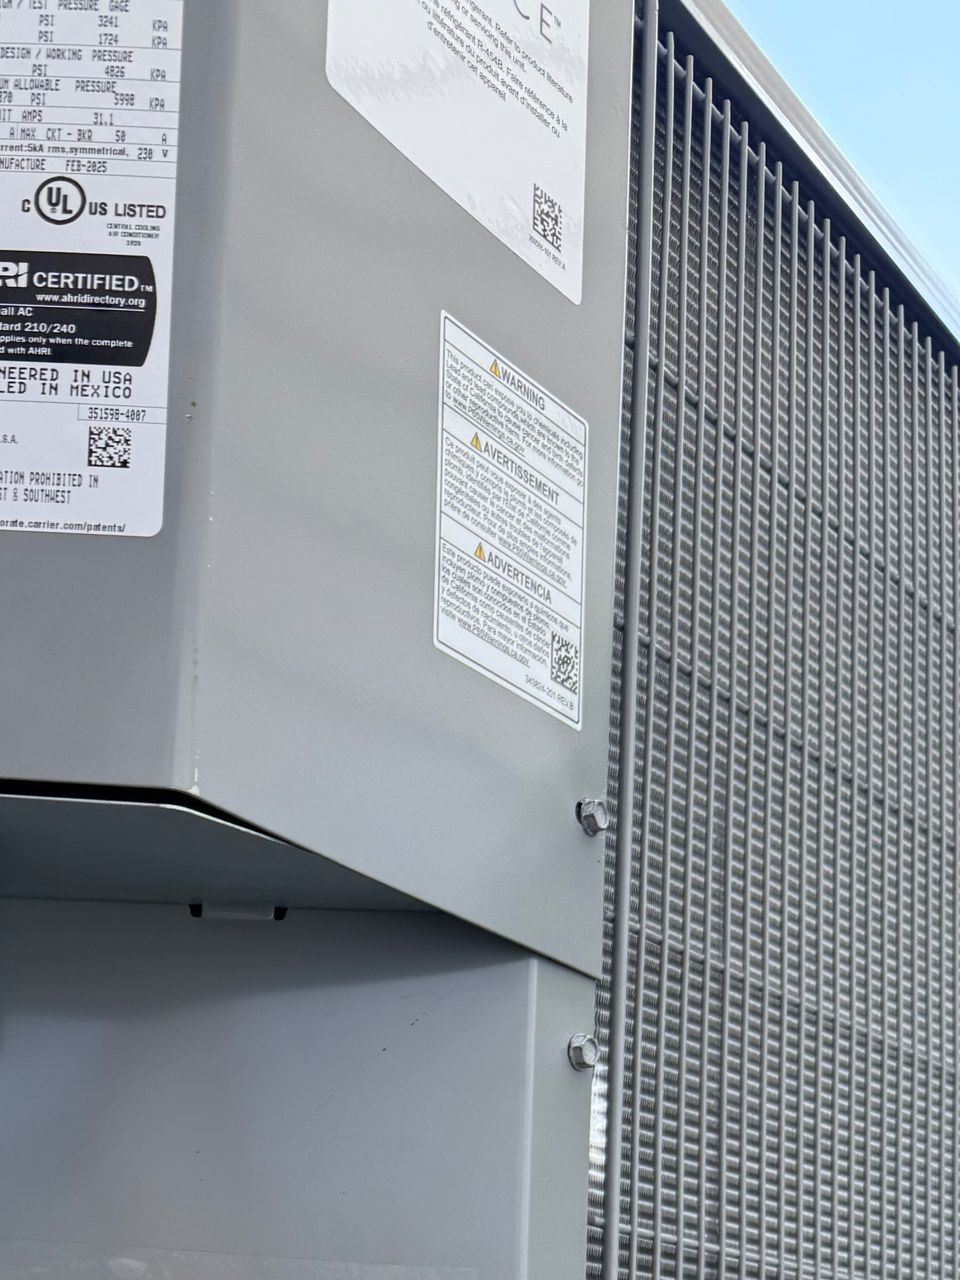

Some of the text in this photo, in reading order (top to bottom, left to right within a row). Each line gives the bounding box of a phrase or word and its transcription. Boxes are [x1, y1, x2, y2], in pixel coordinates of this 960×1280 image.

[57, 2, 98, 11] PRESSURE
[108, 4, 130, 12] GAGE
[38, 14, 54, 26] PSI
[98, 15, 119, 27] 3241
[152, 20, 168, 31] KPA
[37, 30, 53, 42] PSI
[98, 33, 118, 45] 1724
[151, 36, 167, 48] KPA
[0, 47, 31, 59] DESIGN
[46, 48, 82, 60] WORKING
[92, 50, 133, 62] PRESSURE
[31, 64, 47, 75] PSI
[104, 66, 125, 77] 4826
[150, 69, 166, 80] KPA
[13, 78, 60, 91] ALLOWABLE
[75, 80, 116, 93] PRESSURE
[30, 93, 46, 105] PSI
[113, 93, 135, 105] 5998
[149, 98, 164, 110] KPA
[21, 110, 42, 122] AMPS
[92, 113, 113, 125] 31.1
[20, 128, 36, 139] MAX
[45, 129, 61, 140] CKT
[76, 130, 92, 141] BKR
[114, 130, 125, 142] 50
[137, 148, 153, 160] 230
[65, 160, 107, 172] FEB-2025
[46, 186, 73, 214] UL
[88, 201, 107, 215] US
[114, 203, 166, 218] LISTED
[32, 272, 138, 291] CERTIFIED
[35, 292, 145, 307] www.ahridirectory.org
[17, 307, 33, 316] AC
[24, 322, 75, 333] 210/240
[28, 336, 46, 344] only
[49, 336, 72, 345] when
[74, 337, 88, 345] the
[91, 338, 133, 348] complete
[7, 346, 25, 354] with
[72, 370, 90, 383] IN
[102, 371, 132, 384] USA
[40, 382, 58, 395] IN
[69, 384, 131, 399] MEXICO
[501, 366, 545, 411] WARNING
[29, 472, 82, 487] PROHIBITED
[88, 474, 98, 488] IN
[483, 441, 560, 505] AVERTISSEMENT
[23, 488, 71, 504] SOUTHWEST
[487, 552, 552, 604] ADVERTENCIA
